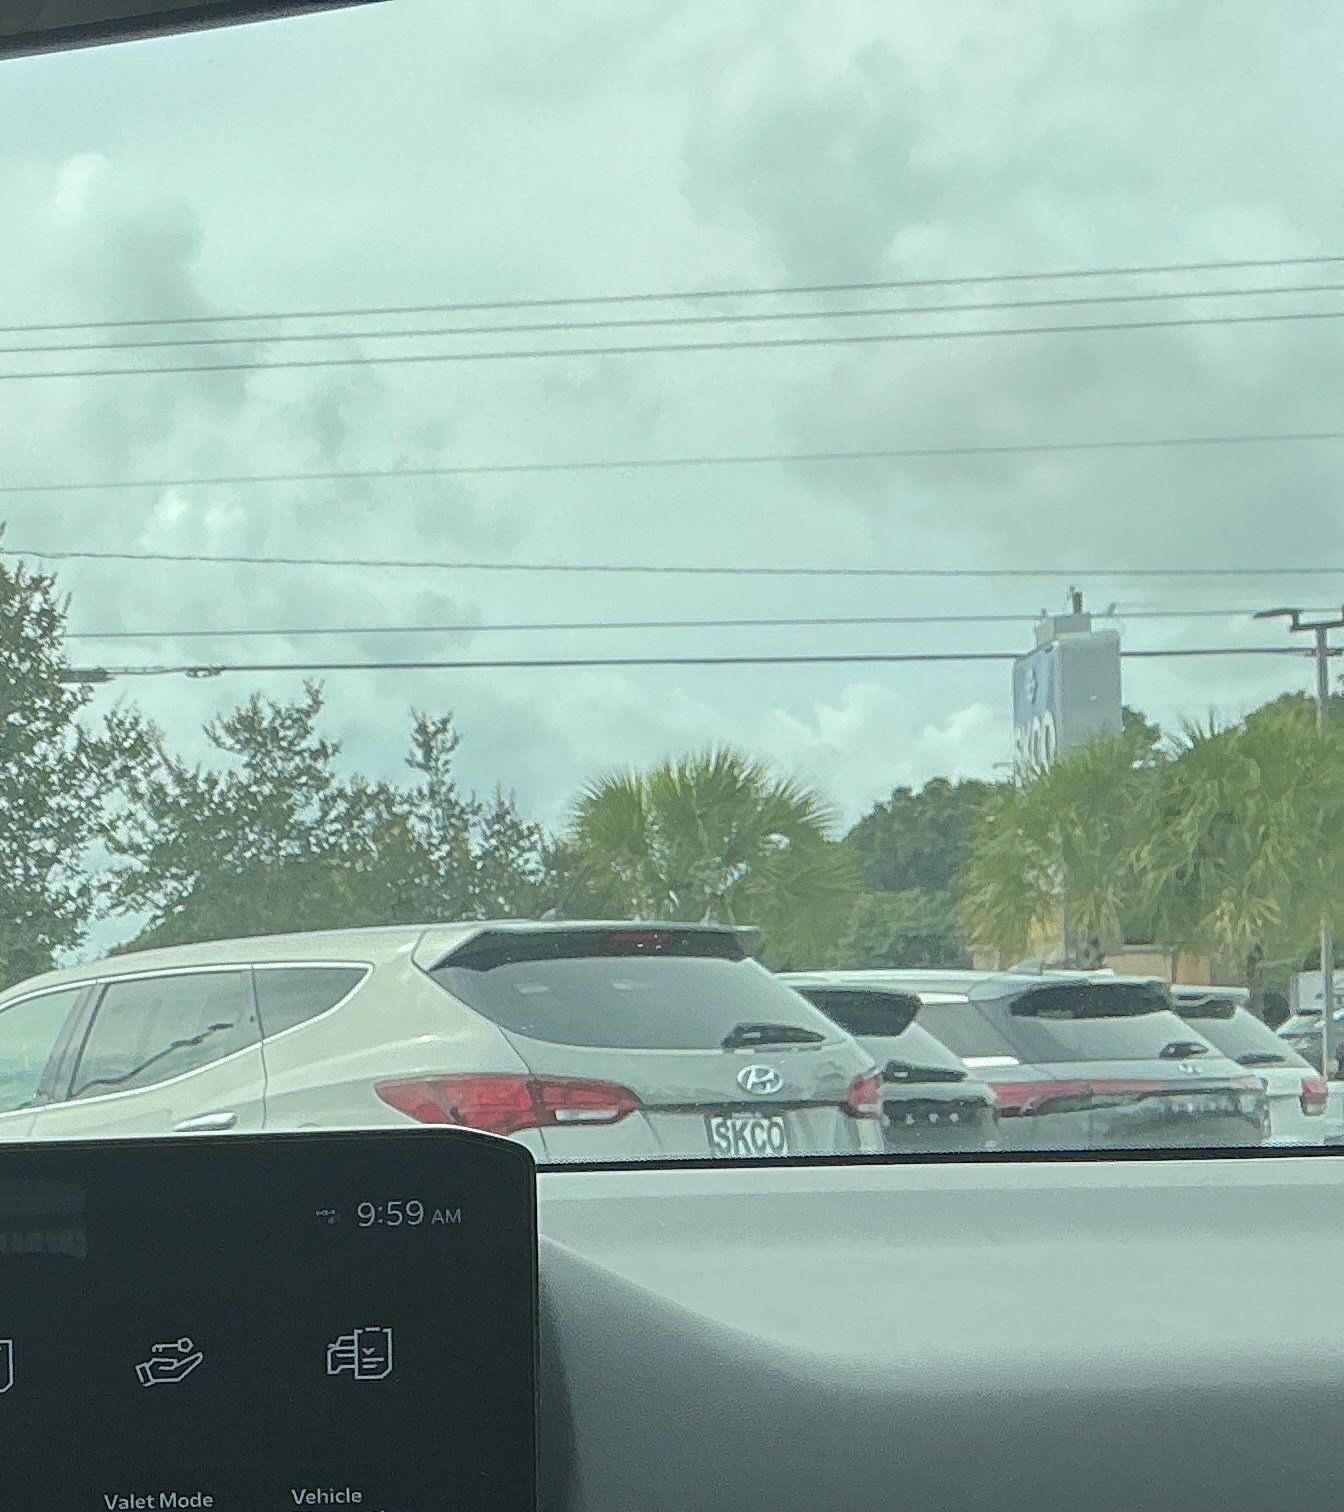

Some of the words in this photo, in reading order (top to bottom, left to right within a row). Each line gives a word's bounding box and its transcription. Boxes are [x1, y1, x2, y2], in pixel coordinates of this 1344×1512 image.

[713, 1119, 785, 1157] SKCO
[358, 1201, 423, 1226] 9:59
[432, 1209, 461, 1223] AM
[105, 1494, 154, 1510] Valet
[160, 1492, 213, 1508] Mode
[292, 1488, 361, 1504] Vehicle
